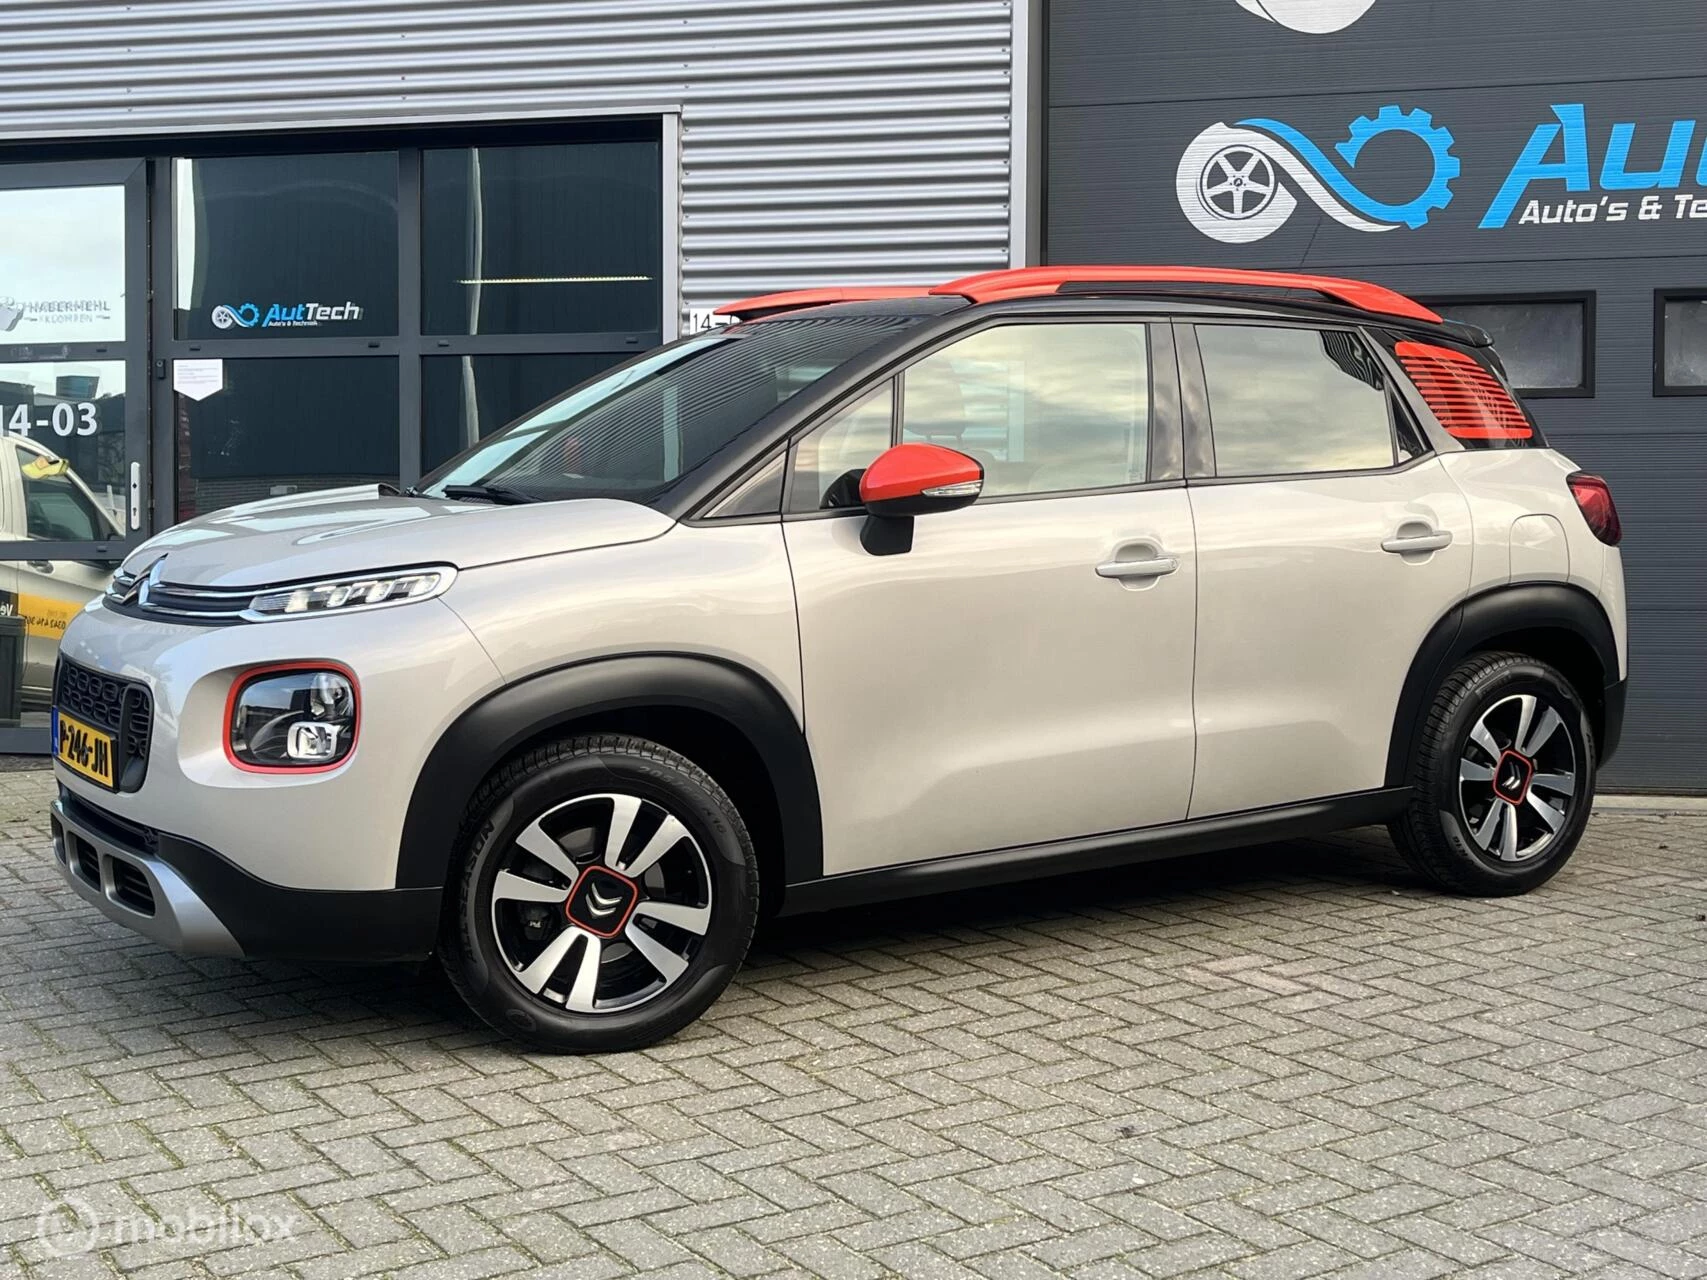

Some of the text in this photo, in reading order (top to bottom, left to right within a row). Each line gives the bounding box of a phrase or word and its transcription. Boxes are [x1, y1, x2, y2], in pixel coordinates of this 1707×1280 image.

[1478, 103, 1707, 228] Au
[1518, 195, 1629, 225] Auto's
[1638, 195, 1663, 220] &
[261, 301, 362, 328] AutTech
